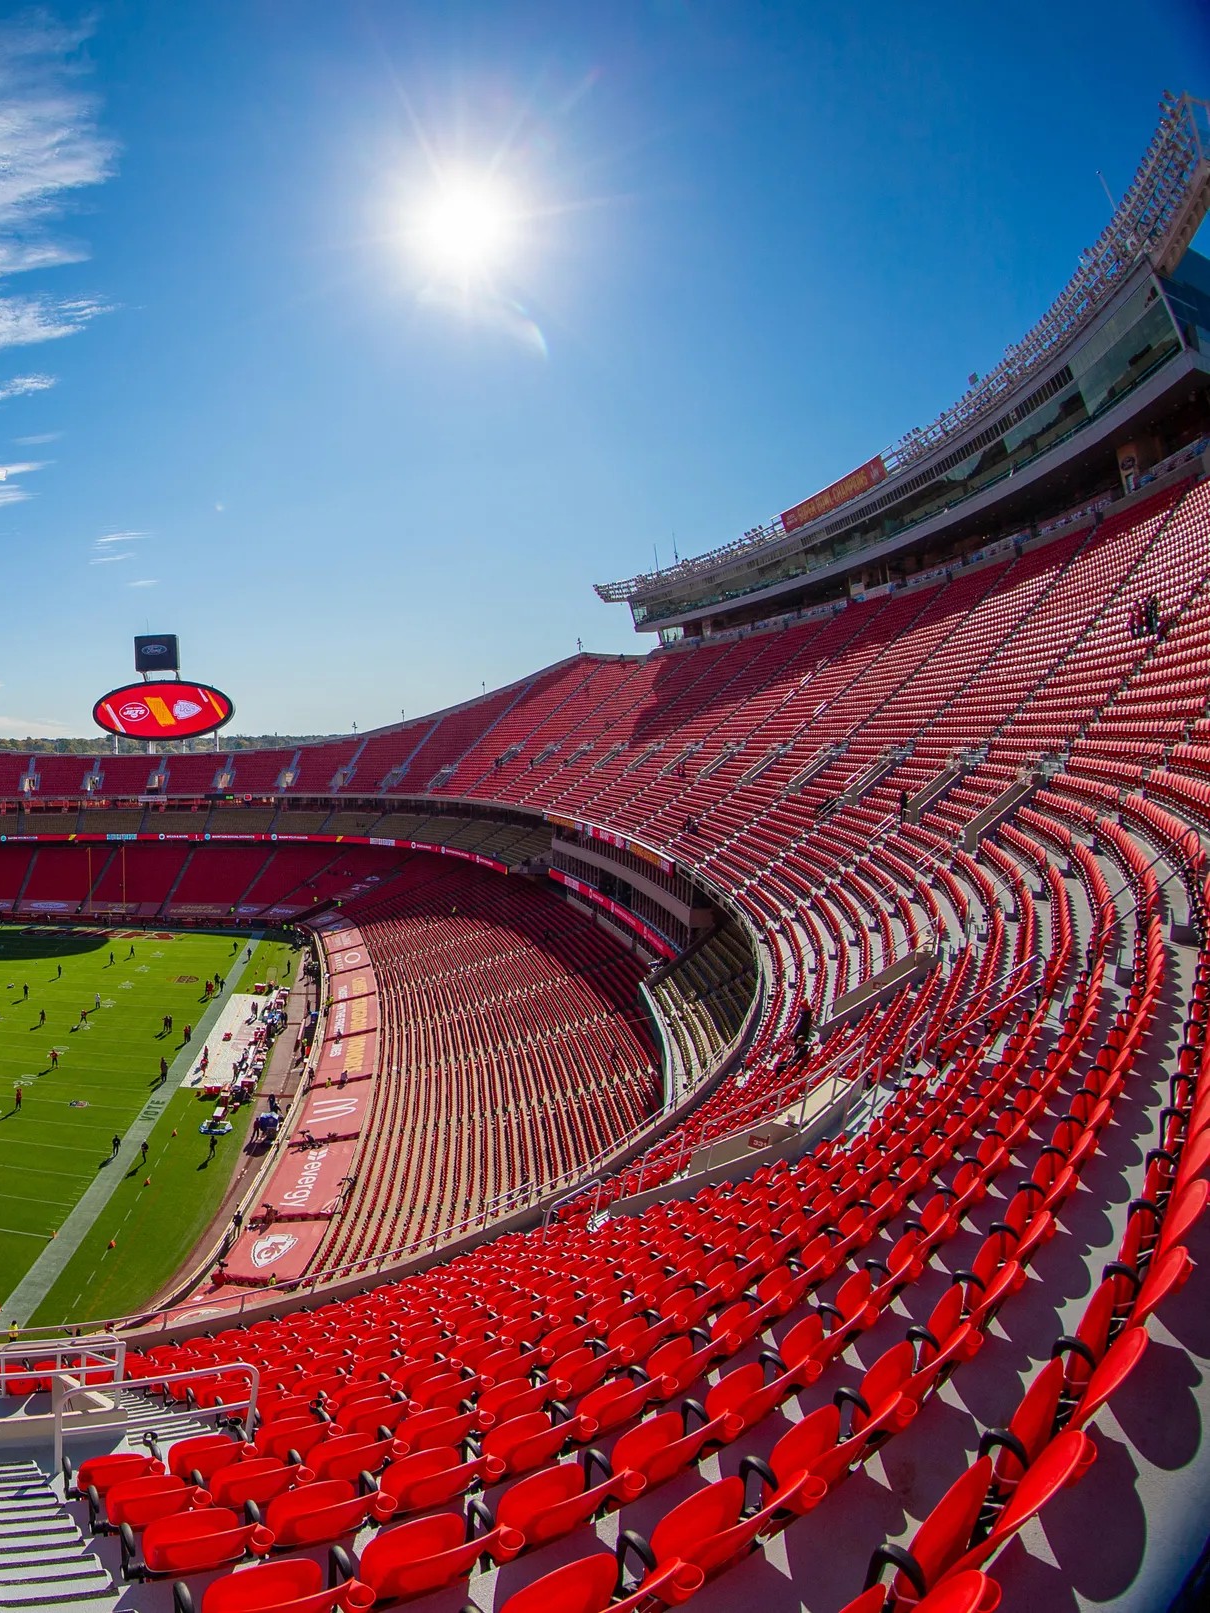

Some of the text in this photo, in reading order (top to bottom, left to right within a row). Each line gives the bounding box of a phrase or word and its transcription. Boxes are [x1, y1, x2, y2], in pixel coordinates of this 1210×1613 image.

[344, 1035, 367, 1073] HONORS
[13, 1074, 38, 1086] 30
[139, 1099, 166, 1122] VOTE
[280, 1162, 323, 1207] evergy
